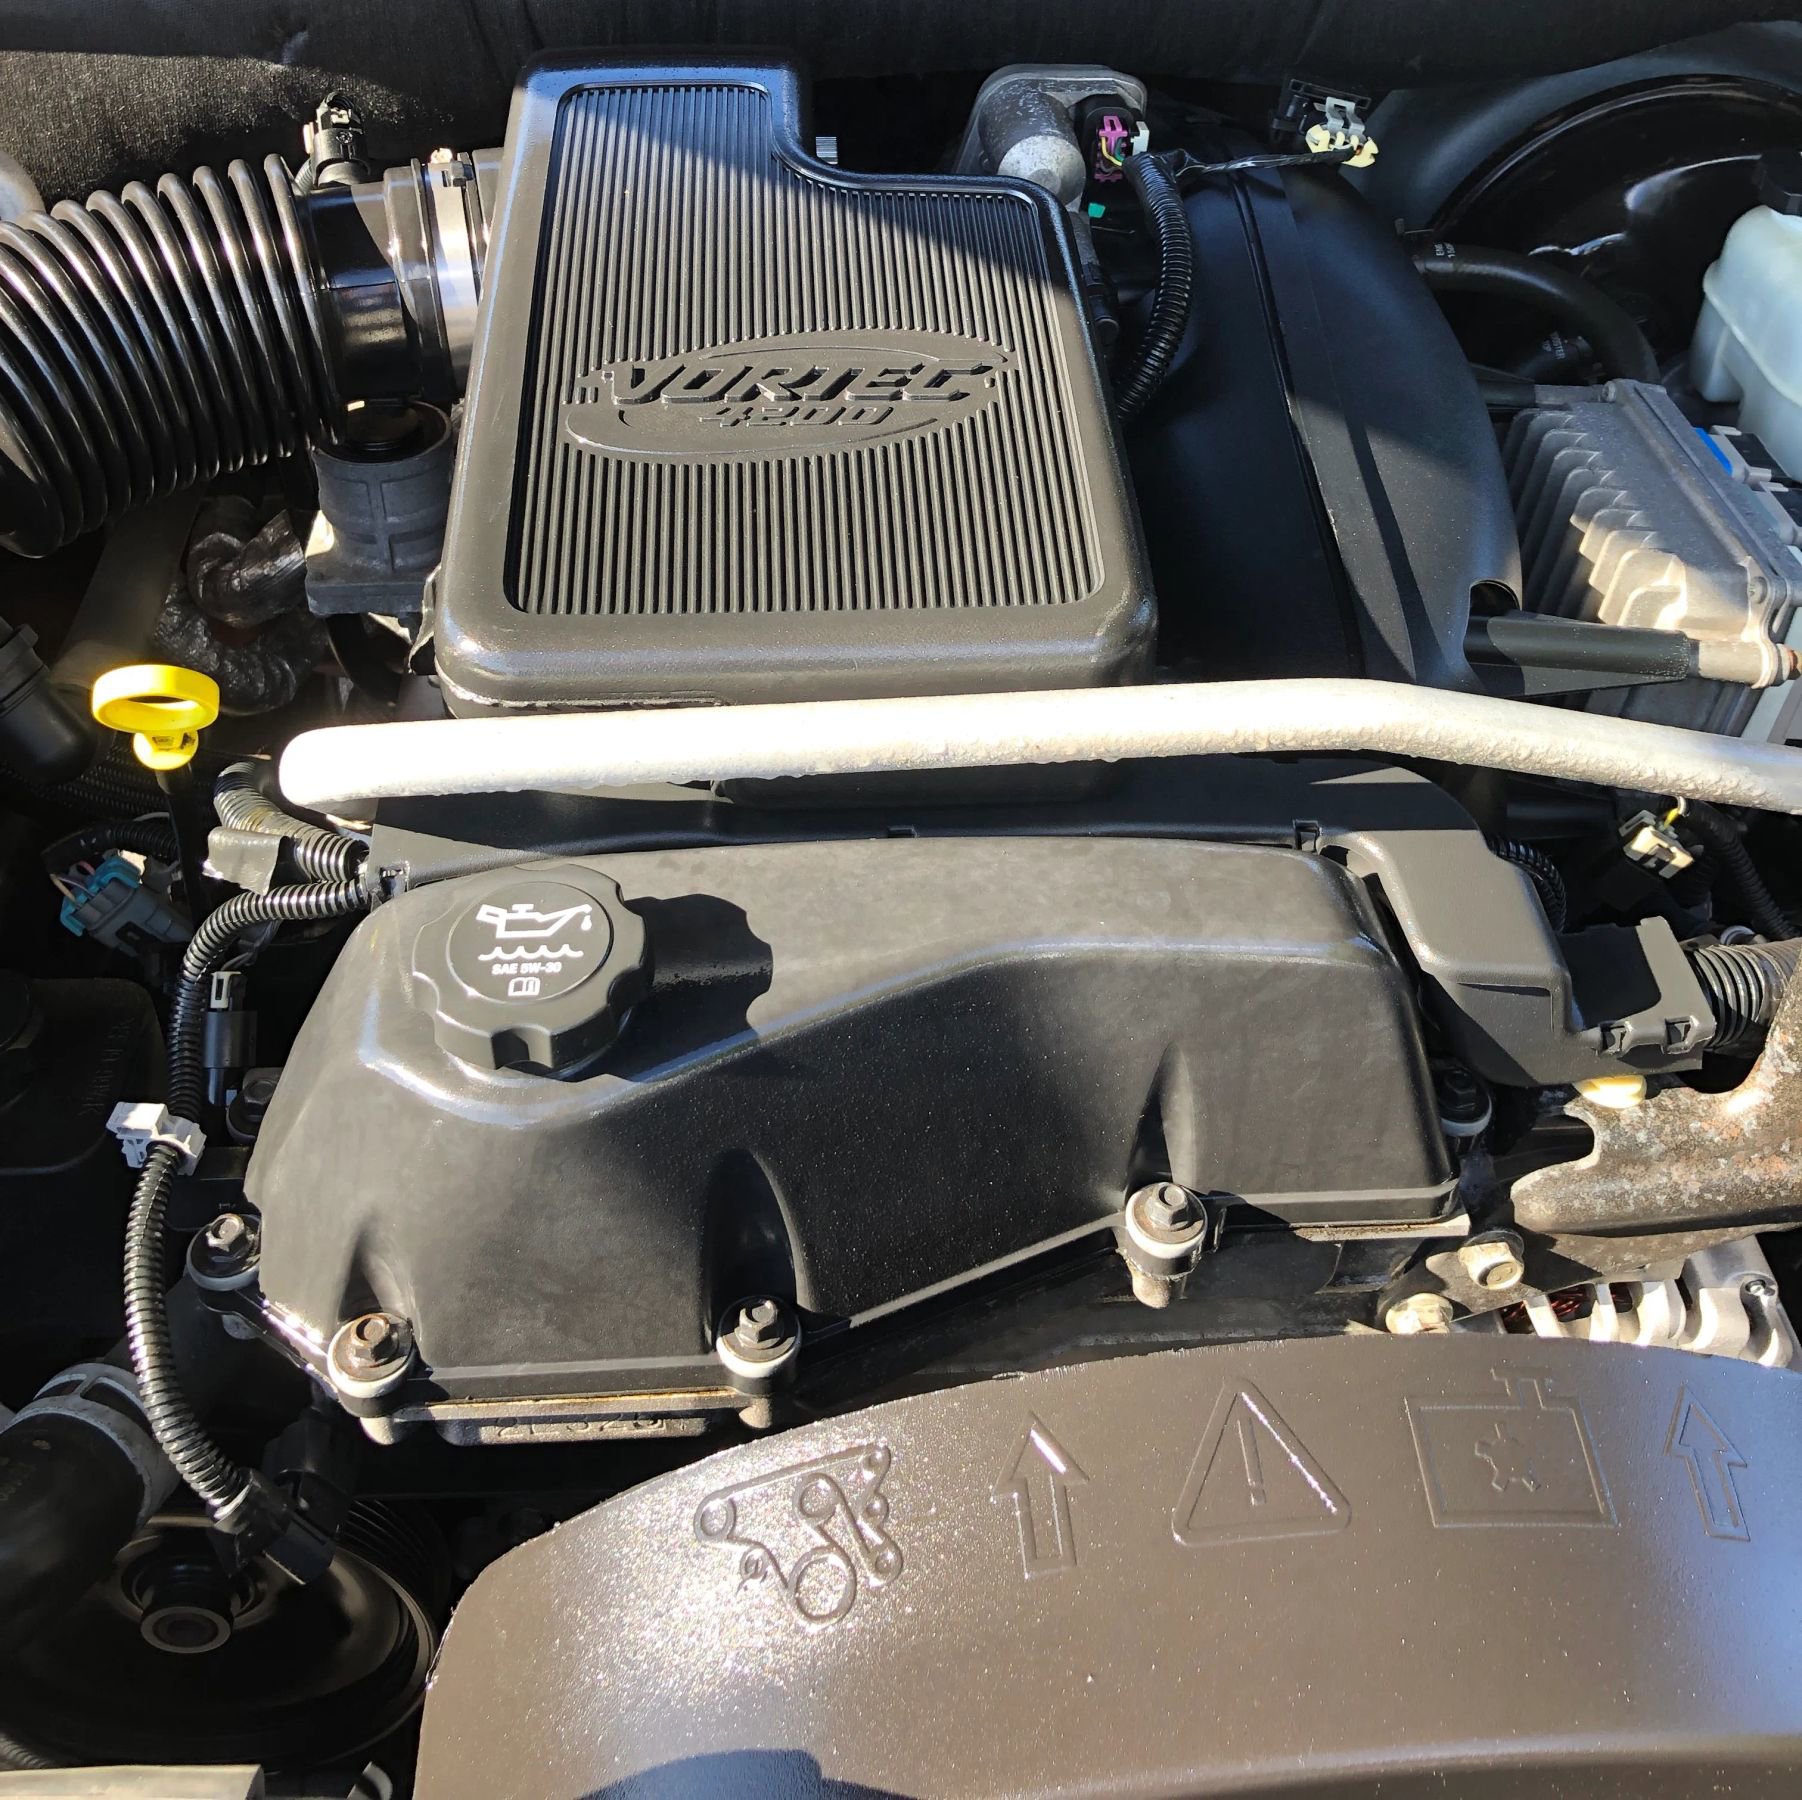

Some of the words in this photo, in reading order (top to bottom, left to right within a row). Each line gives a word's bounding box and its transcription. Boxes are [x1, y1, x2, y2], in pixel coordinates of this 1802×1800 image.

[600, 362, 992, 404] VORTEC
[699, 405, 893, 427] 4200
[491, 963, 519, 976] SAE
[520, 961, 562, 975] 5W-30
